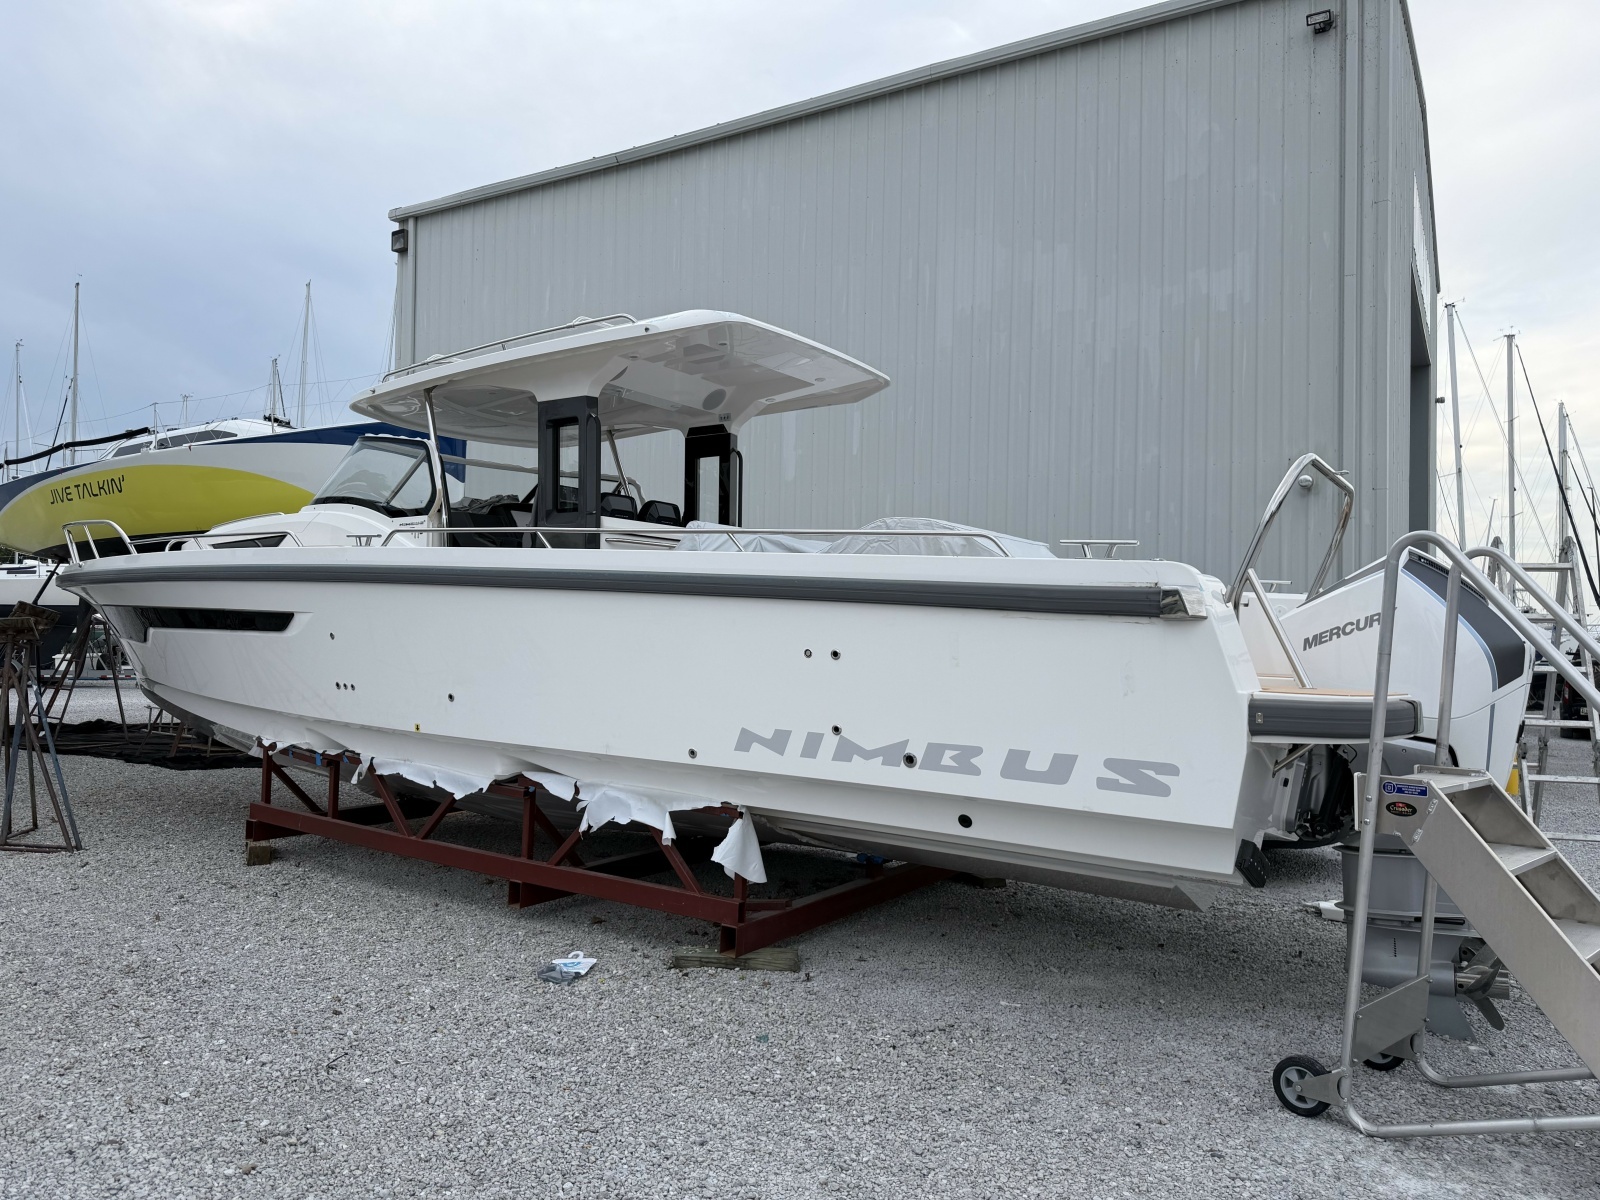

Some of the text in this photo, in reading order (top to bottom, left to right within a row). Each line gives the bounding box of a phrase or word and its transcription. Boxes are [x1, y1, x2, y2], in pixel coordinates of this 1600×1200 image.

[50, 474, 125, 505] JIVE TALKIN'
[1303, 607, 1397, 651] MERCUR
[733, 727, 1181, 798] NIMBUS
